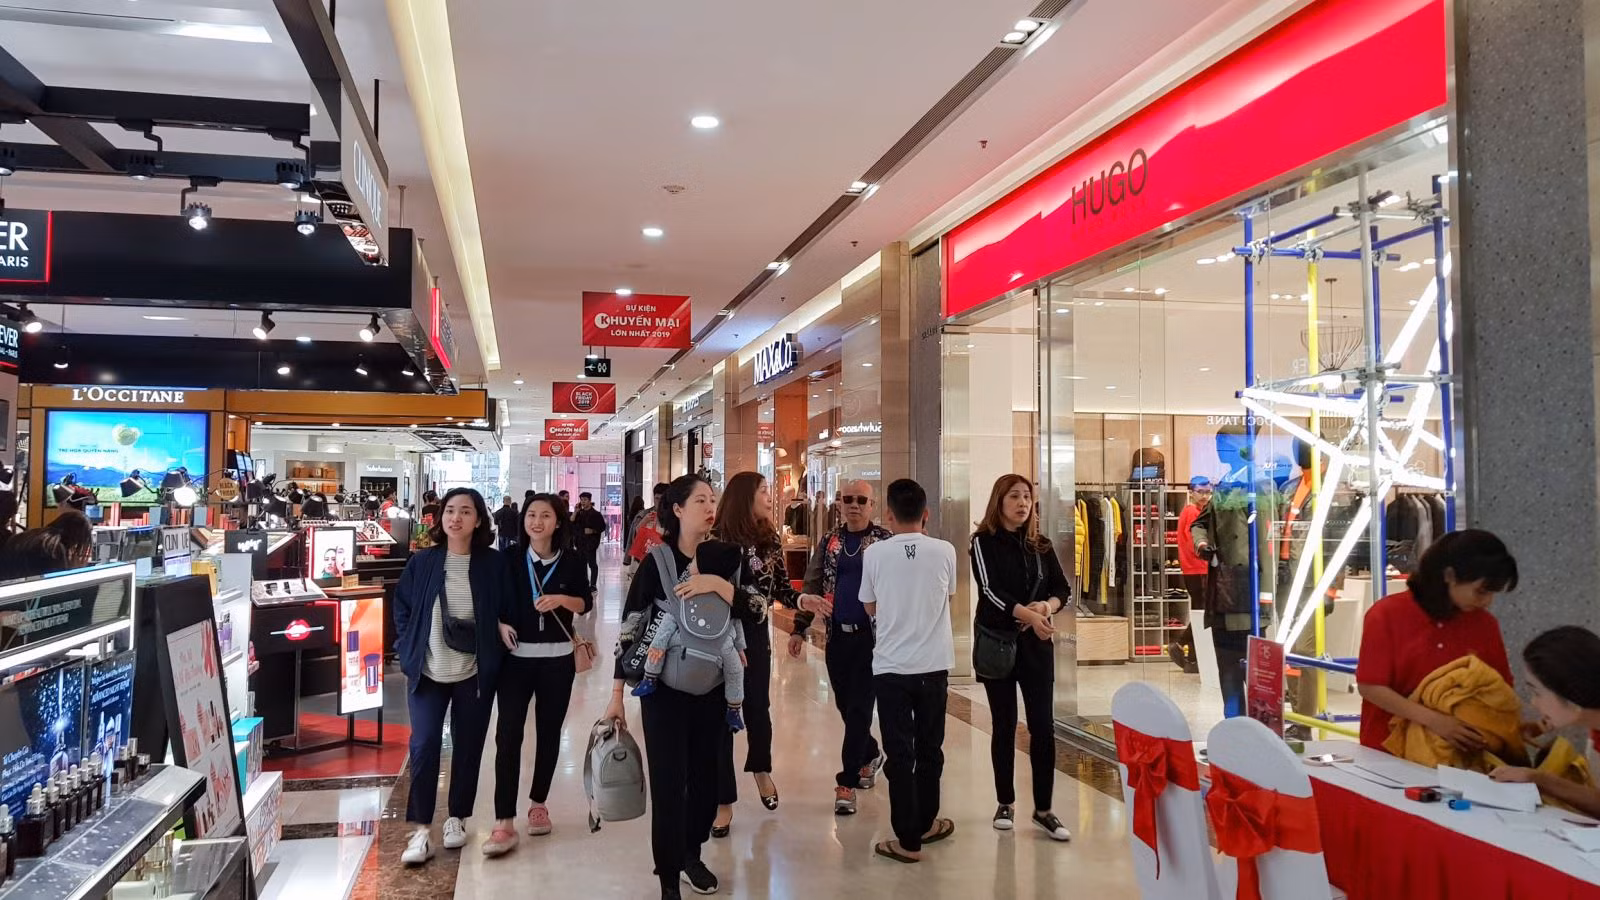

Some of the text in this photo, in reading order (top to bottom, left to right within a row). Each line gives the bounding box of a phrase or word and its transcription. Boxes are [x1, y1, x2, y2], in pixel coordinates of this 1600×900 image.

[1072, 148, 1148, 224] HUGO
[625, 304, 657, 313] SỰ KIỆN
[598, 314, 680, 330] KHUYẾN MẠI
[610, 329, 671, 339] LỚN NHẤT 2019
[72, 386, 185, 404] L'OCCITANE
